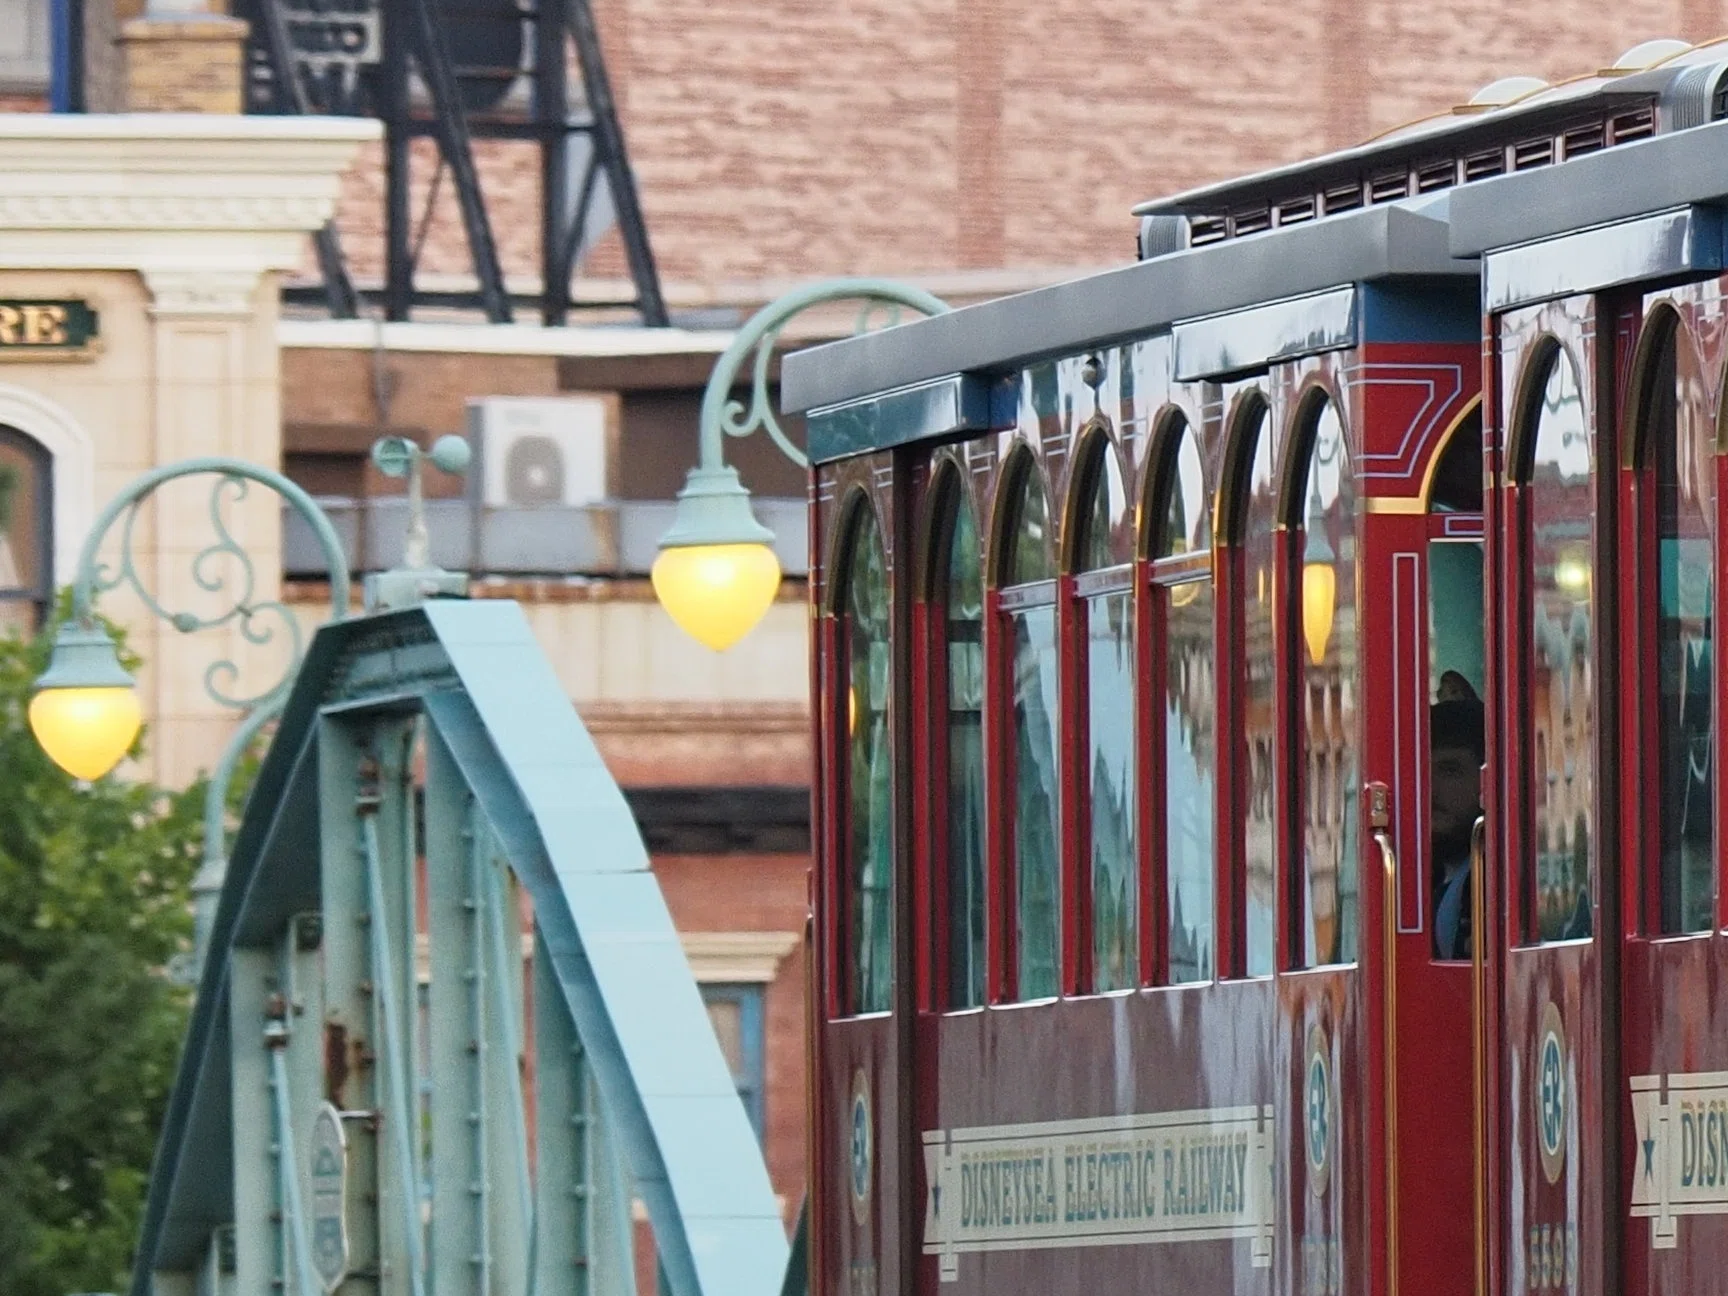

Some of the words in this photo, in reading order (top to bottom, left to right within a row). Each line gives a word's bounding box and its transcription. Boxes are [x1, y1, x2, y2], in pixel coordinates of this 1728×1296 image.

[960, 1146, 1058, 1229] DISNEYSEA
[1063, 1138, 1156, 1223] ELECTRIC
[1161, 1131, 1248, 1216] RAILWAY
